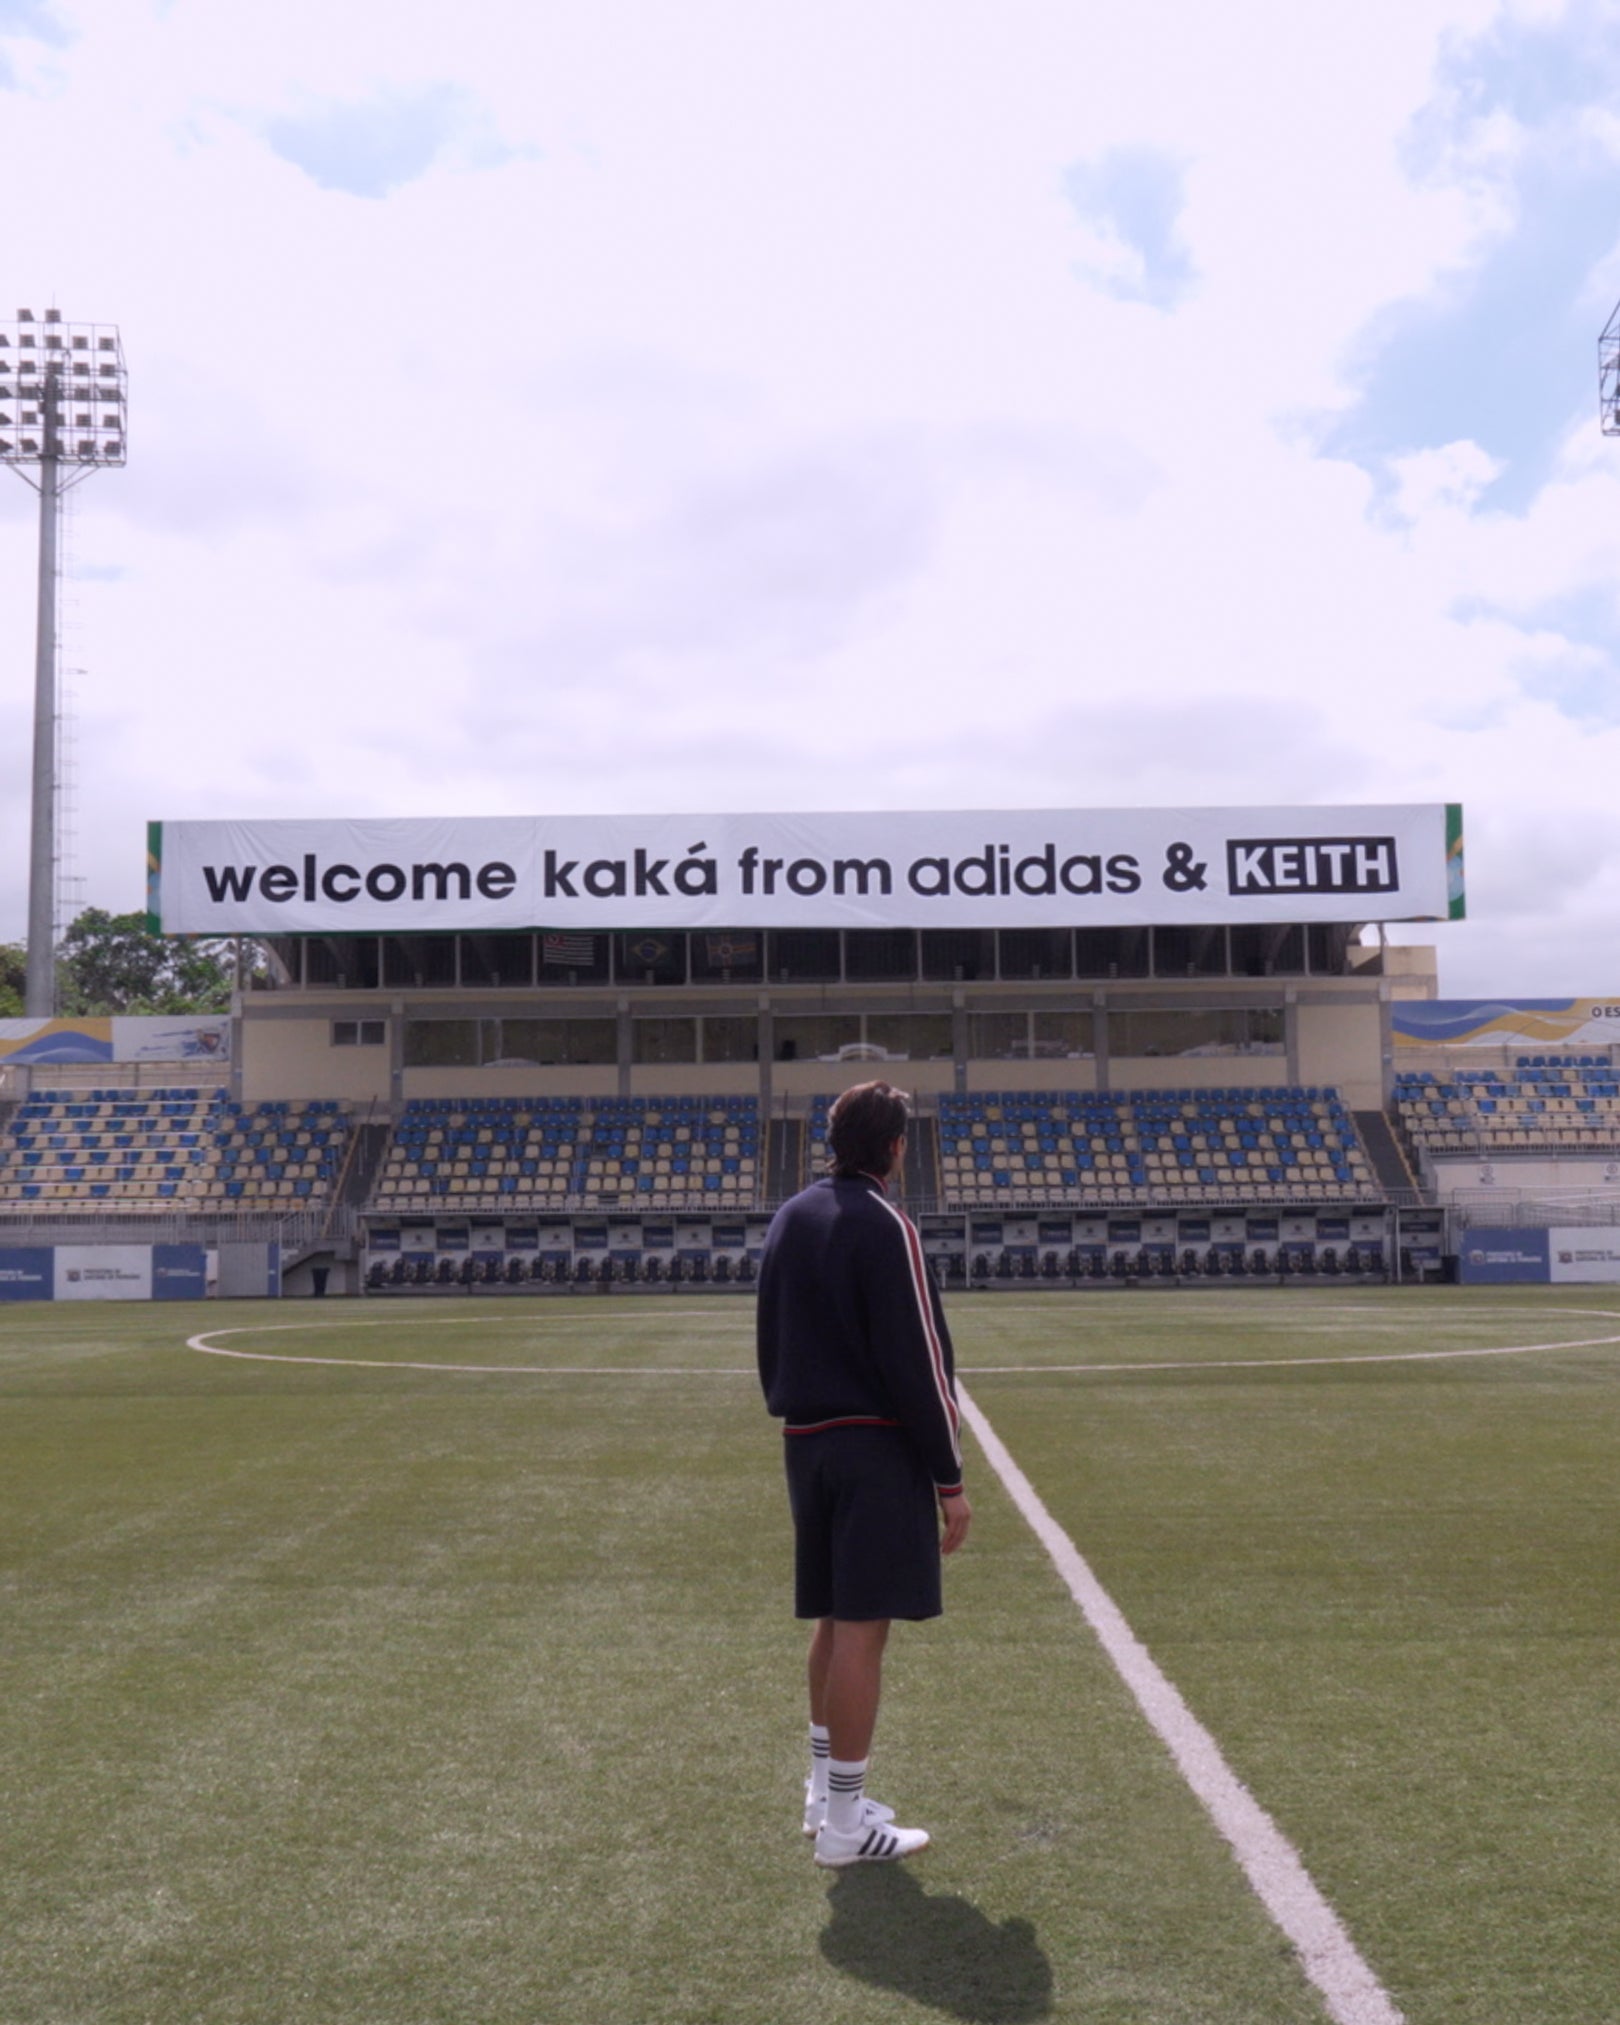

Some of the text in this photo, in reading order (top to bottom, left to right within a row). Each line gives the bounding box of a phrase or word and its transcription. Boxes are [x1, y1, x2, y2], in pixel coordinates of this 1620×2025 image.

[202, 841, 1392, 903] welcome kaká from adidas & KEITH
[1591, 1005, 1602, 1019] O
